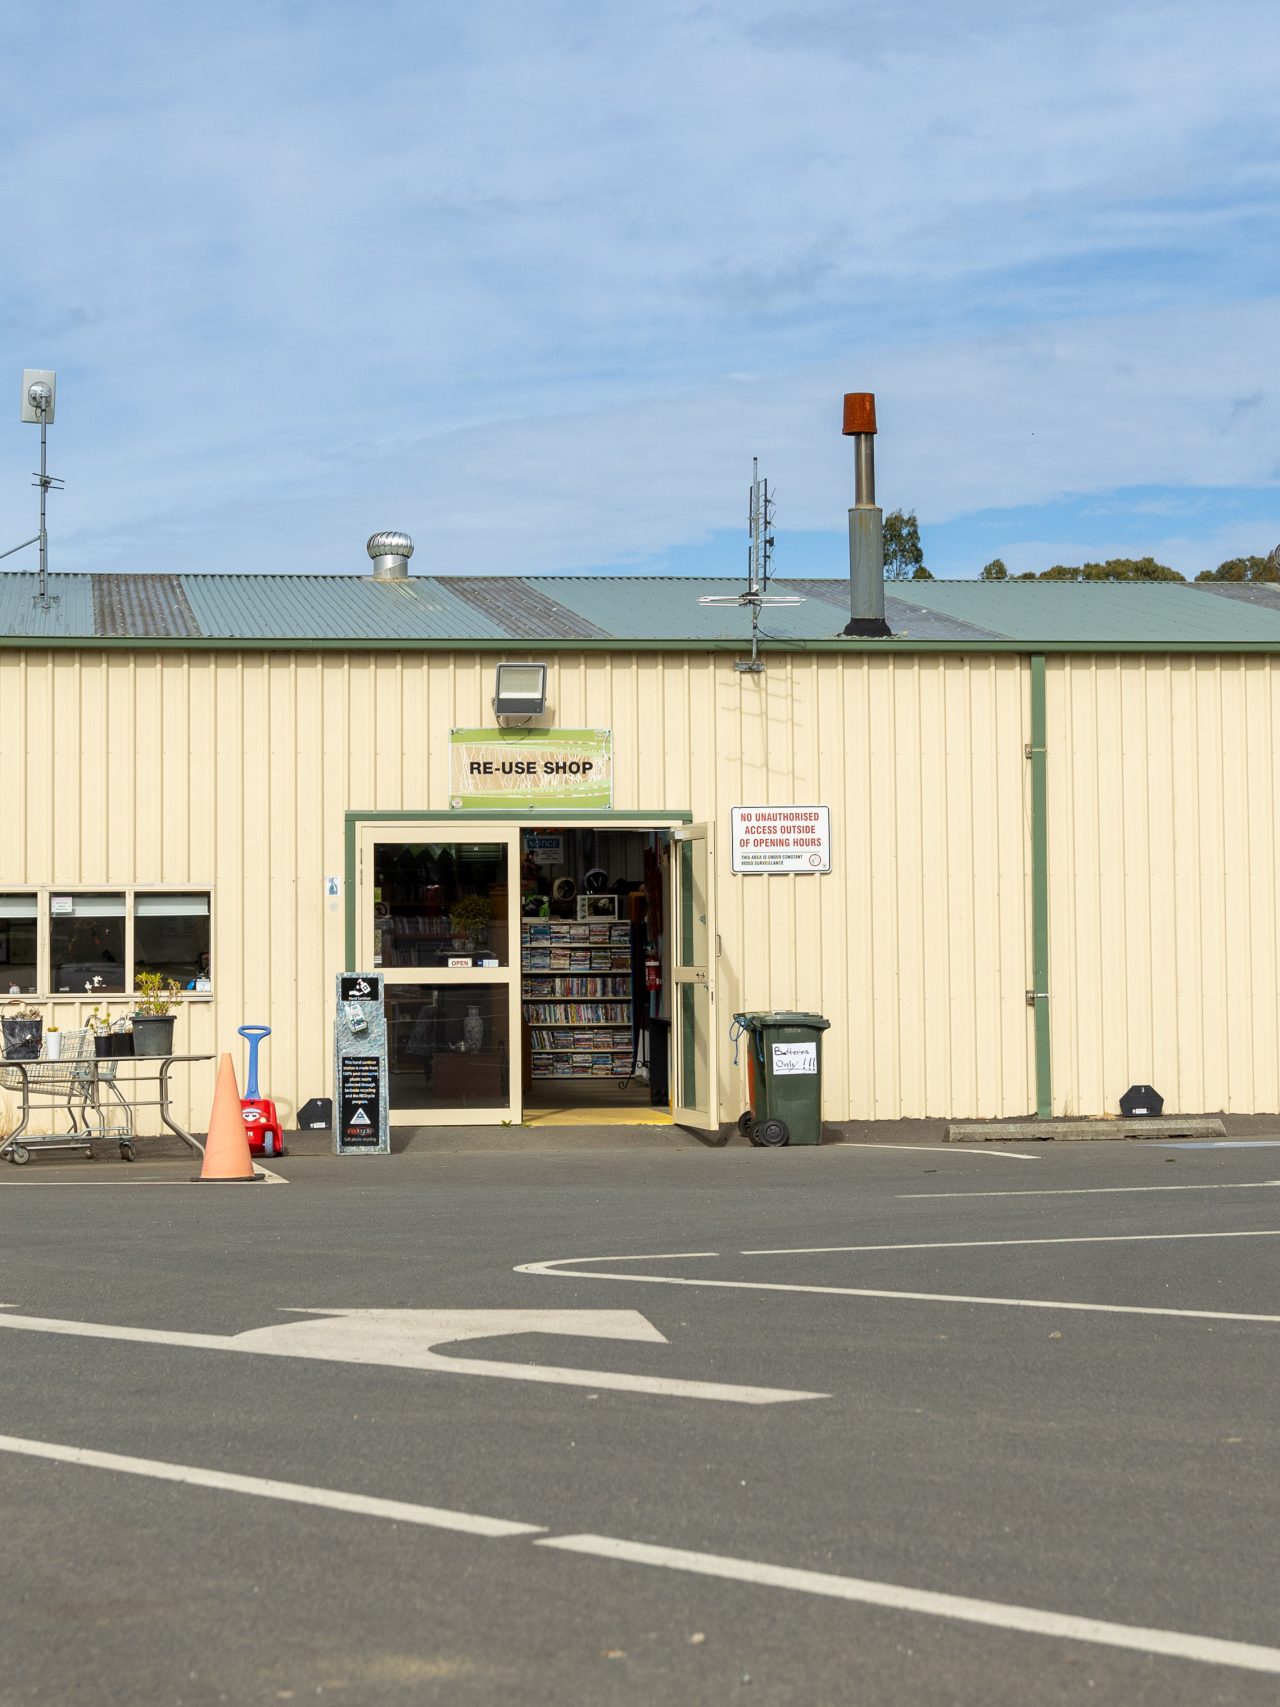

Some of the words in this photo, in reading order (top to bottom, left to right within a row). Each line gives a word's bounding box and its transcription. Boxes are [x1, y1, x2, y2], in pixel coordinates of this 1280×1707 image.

[470, 762, 536, 775] RE-USE
[544, 762, 593, 775] SHOP
[741, 813, 752, 822] NO
[756, 813, 819, 822] UNAUTHORISED
[745, 826, 777, 834] ACCESS
[781, 826, 816, 834] OUTSIDE
[529, 840, 558, 848] NOTICE
[740, 838, 750, 847] OF
[754, 838, 790, 847] OPENING
[793, 838, 822, 847] HOURS
[774, 1047, 810, 1056] Batteries
[776, 1060, 798, 1072] Only
